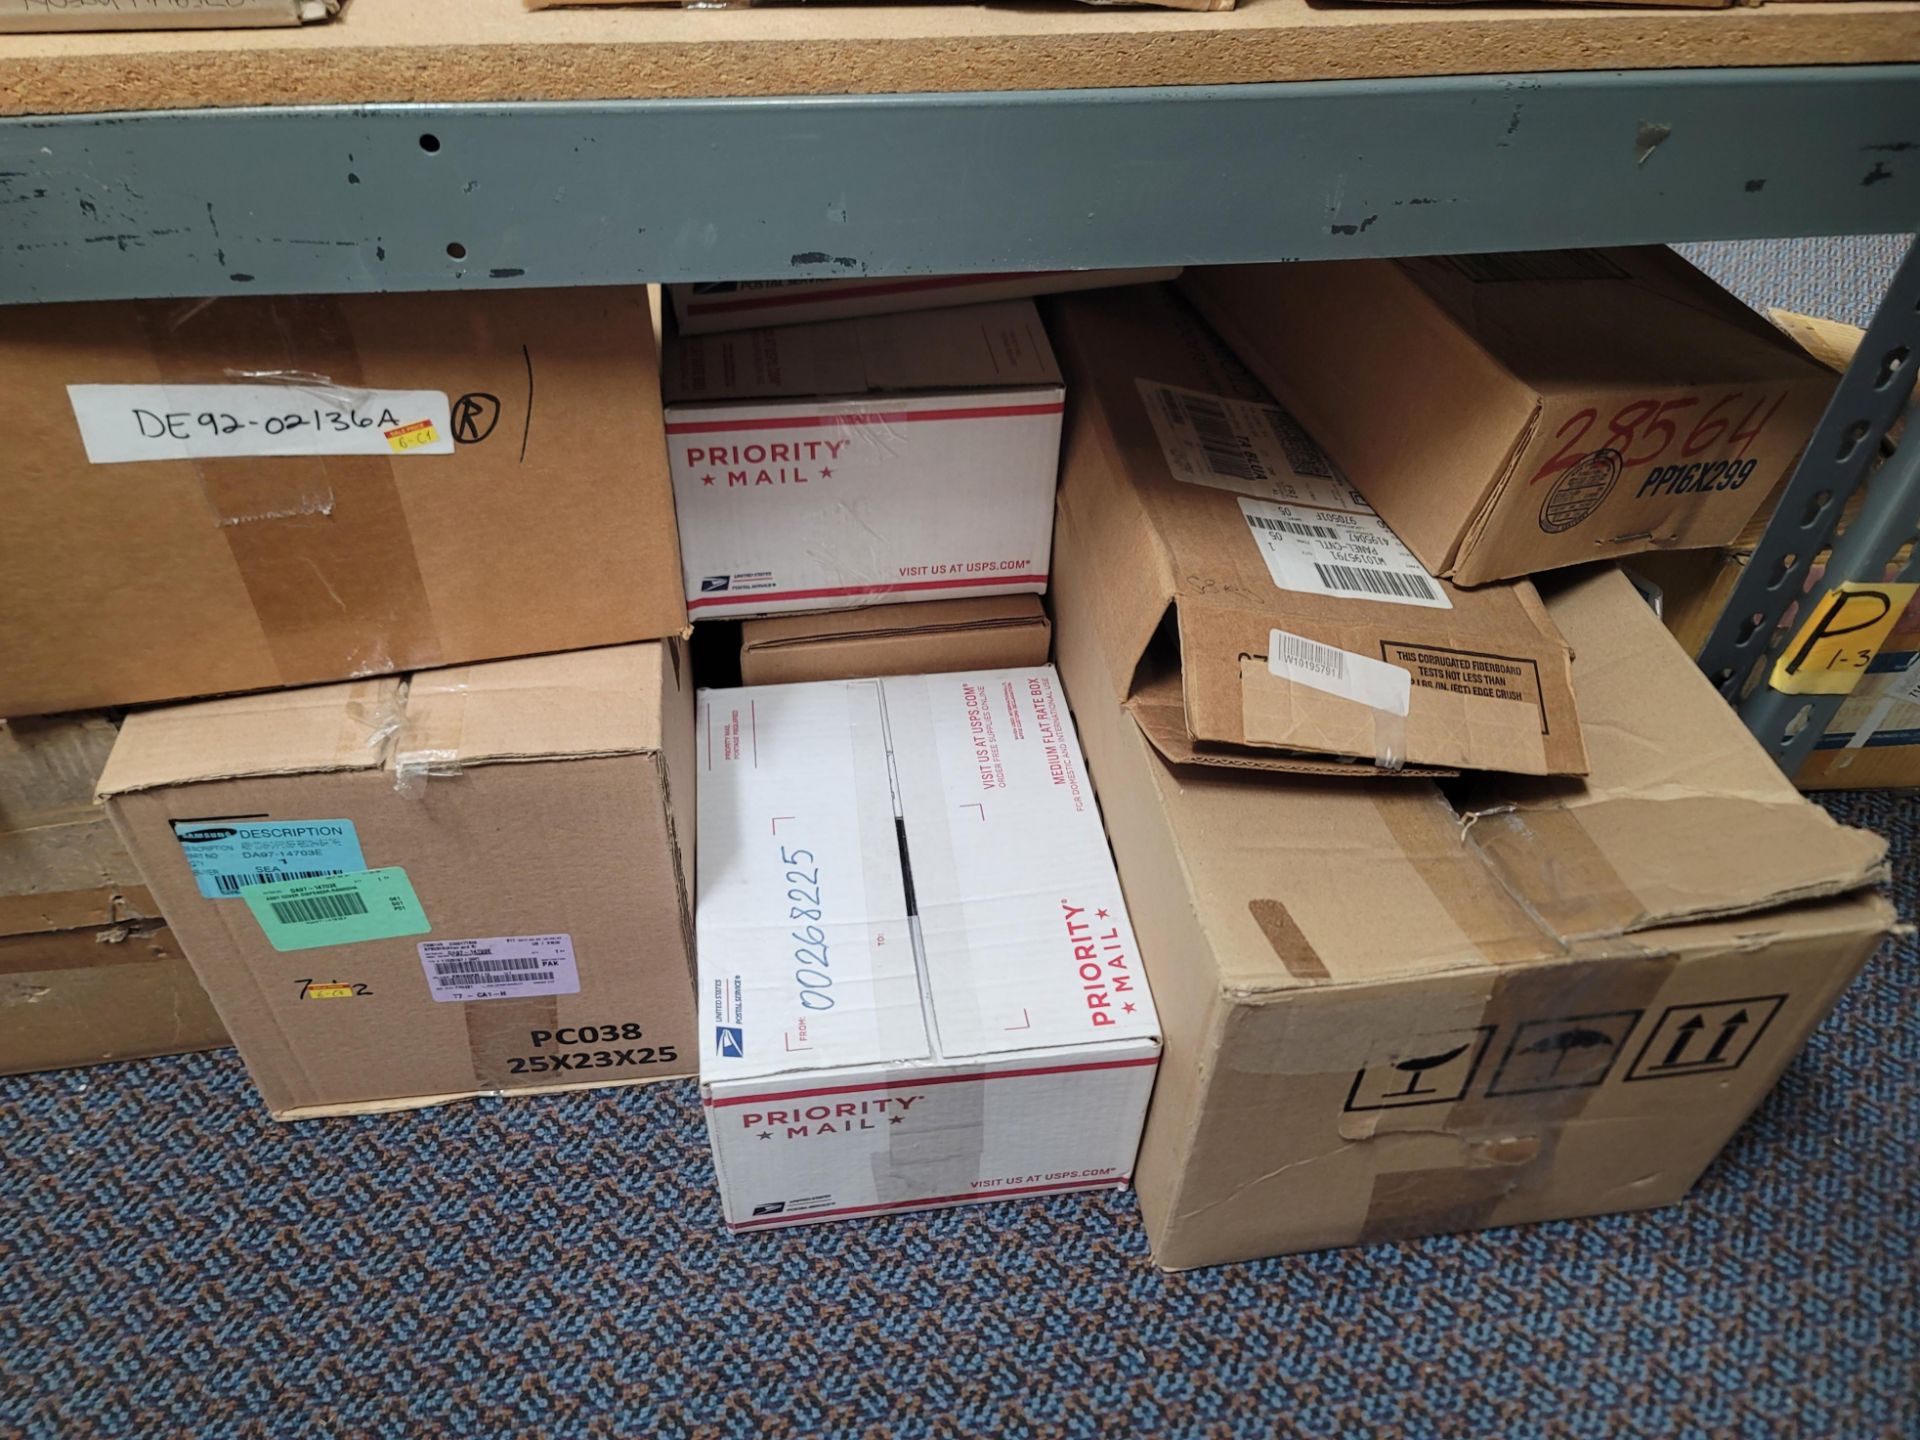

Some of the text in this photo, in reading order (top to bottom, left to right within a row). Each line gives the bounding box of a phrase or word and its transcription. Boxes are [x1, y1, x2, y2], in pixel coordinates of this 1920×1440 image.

[134, 406, 400, 440] DE92-02136A
[1530, 390, 1788, 485] 28564
[728, 466, 808, 487] MAIL
[1636, 458, 1757, 499] PP16X299
[1314, 540, 1379, 556] PANEL-CNTL
[1329, 550, 1386, 565] W10195791
[899, 566, 929, 577] VISIT
[931, 565, 947, 575] US
[948, 563, 963, 573] AT
[1785, 589, 1891, 676] P
[1283, 654, 1336, 677] W10195791
[1397, 650, 1522, 676] THIS CORRUGATED FIBERBOARD
[1826, 648, 1870, 671] 1-3
[1418, 666, 1507, 686] TESTS NOT LESS THAN
[1472, 687, 1494, 698] EDGE
[1495, 689, 1523, 701] CRUSH
[1046, 692, 1065, 742] INTERNATIONAL
[973, 735, 987, 748] AT
[976, 685, 1006, 788] ORDER FREE SUPPLIES ONLINE
[1027, 677, 1067, 785] MEDIUM FLAT RATE BOX
[977, 749, 990, 762] US
[1058, 743, 1069, 758] AND
[980, 762, 995, 789] VISIT
[1063, 759, 1080, 795] DOMESTIC
[1072, 796, 1084, 812] FOR
[239, 827, 343, 839] DESCRIPTION
[243, 849, 323, 859] DA97-14703E
[780, 845, 837, 1010] 00268225
[1100, 926, 1133, 993] MAIL
[714, 979, 723, 1023] UNITED STATES
[735, 1002, 743, 1025] POSTAL
[531, 1022, 643, 1048] PC038
[798, 1016, 808, 1041] FROM:
[507, 1046, 678, 1075] 25X23X25
[786, 1114, 877, 1140] MAIL
[971, 1178, 1003, 1189] VISIT
[1006, 1176, 1023, 1186] US
[1026, 1174, 1042, 1184] AT
